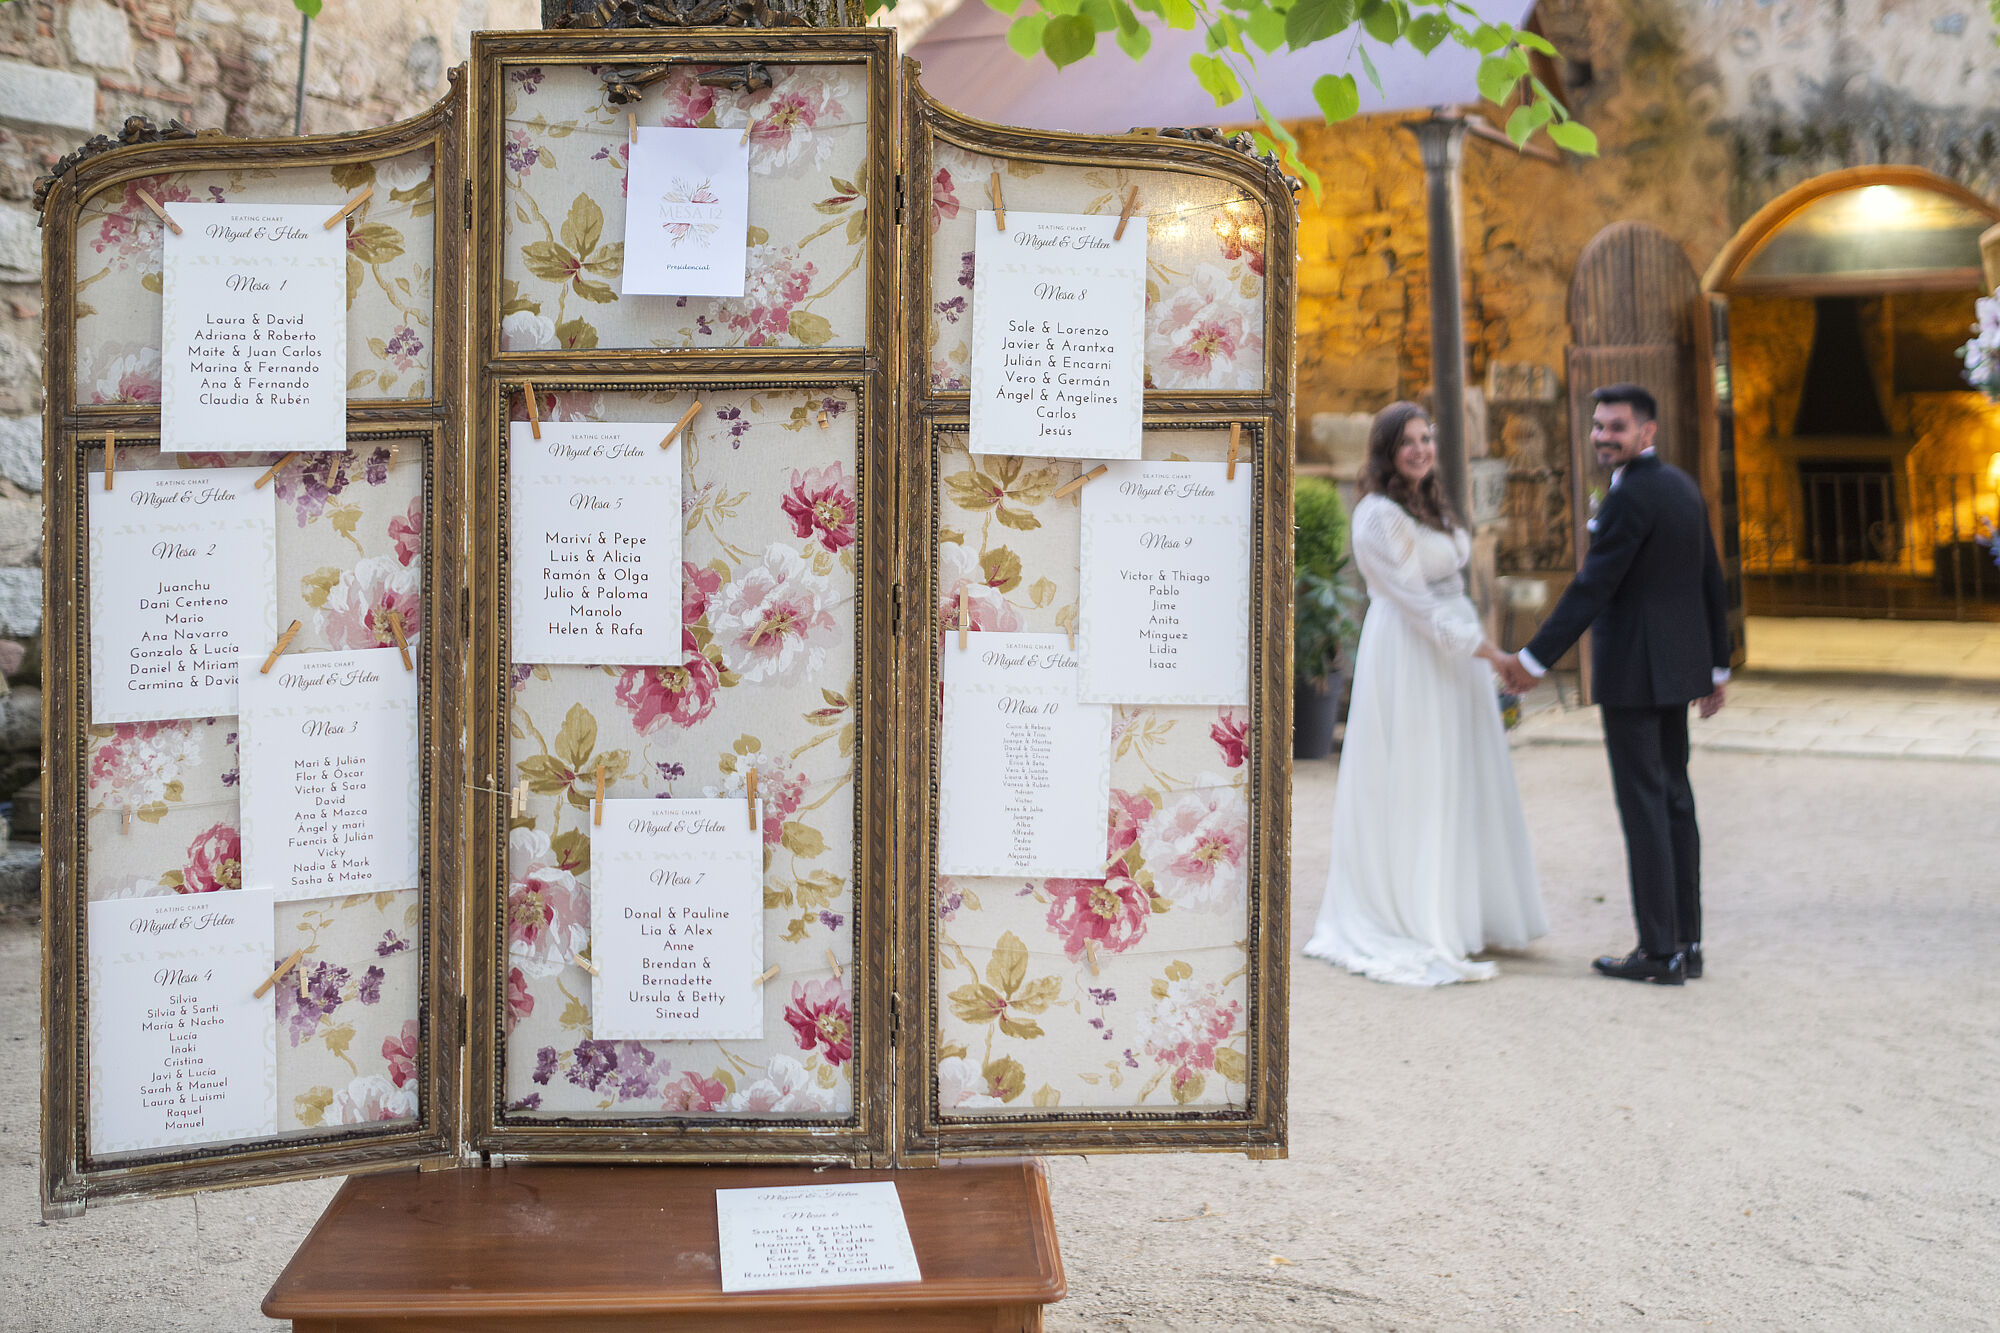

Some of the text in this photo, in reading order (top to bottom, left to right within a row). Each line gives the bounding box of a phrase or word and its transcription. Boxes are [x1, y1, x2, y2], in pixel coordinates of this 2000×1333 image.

[206, 224, 308, 242] Miguel & Helen
[1014, 232, 1111, 250] Miguel & Helen
[226, 274, 288, 292] Mesa 1
[1034, 282, 1088, 301] Mesa 8
[206, 314, 304, 325] Laura & David
[1008, 320, 1109, 336] Sole & Lorenzo
[194, 330, 316, 341] Adriana & Roberto
[188, 345, 322, 358] Maite & Juan Carlos
[1001, 337, 1114, 353] Javier & Arantxa
[190, 361, 320, 373] Marina & Fernando
[1004, 354, 1111, 370] Julián & Encarni
[200, 377, 310, 389] Ana & Fernando
[1005, 371, 1111, 387] Vero & Germán
[199, 393, 310, 405] Claudia & Rubén
[996, 385, 1118, 406] Ángel & Angelines
[1036, 406, 1077, 419] Carlos
[1038, 423, 1072, 437] Jesús
[548, 443, 645, 461] Miguel & Helen
[130, 488, 237, 508] Miguel & Helen
[569, 493, 624, 510] Mesa 5
[545, 532, 647, 548] Mariví & Pepe
[1139, 532, 1193, 549] Mesa 9
[151, 542, 216, 560] Mesa 2
[550, 550, 641, 563] Luis & Alicia
[543, 568, 649, 584] Ramón & Olga
[1120, 570, 1210, 584] Victor & Thiago
[157, 580, 211, 595] Juanchu
[544, 586, 648, 600] Julio & Paloma
[1149, 585, 1180, 596] Pablo
[140, 596, 228, 610] Dani Centeno
[1151, 600, 1176, 611] Jime
[570, 604, 622, 617] Manolo
[165, 613, 204, 624] Mario
[1149, 615, 1179, 625] Anita
[141, 629, 229, 642] Ana Navarro
[549, 622, 644, 636] Helen & Rafa
[1149, 644, 1177, 654] Lidia
[130, 661, 171, 675] Daniel
[177, 660, 186, 672] &
[1149, 659, 1177, 669] Isaac
[127, 679, 184, 691] Carmina
[190, 676, 198, 687] &
[997, 697, 1058, 715] Mesa 10
[301, 719, 359, 737] Mesa 3
[315, 795, 346, 806] David
[318, 847, 346, 858] Vicky
[293, 857, 370, 873] Nadia & Mark
[291, 872, 373, 886] Sasha & Mateo
[650, 869, 706, 886] Mesa 7
[624, 907, 730, 919] Donal & Pauline
[641, 924, 713, 936] Lia & Alex
[663, 940, 694, 951] Anne
[642, 957, 711, 969] Brendan &
[154, 968, 212, 986] Mesa 4
[642, 974, 713, 986] Bernadette
[169, 994, 198, 1005] Silvia
[629, 991, 726, 1005] Ursula & Betty
[147, 1004, 219, 1019] Silvia & Santi
[656, 1007, 700, 1019] Sinead
[164, 1057, 204, 1067] Cristina
[140, 1077, 228, 1095] Sarah & Manuel
[143, 1092, 225, 1108] Laura & Luismi
[167, 1105, 202, 1118] Raquel
[165, 1117, 204, 1130] Manuel
